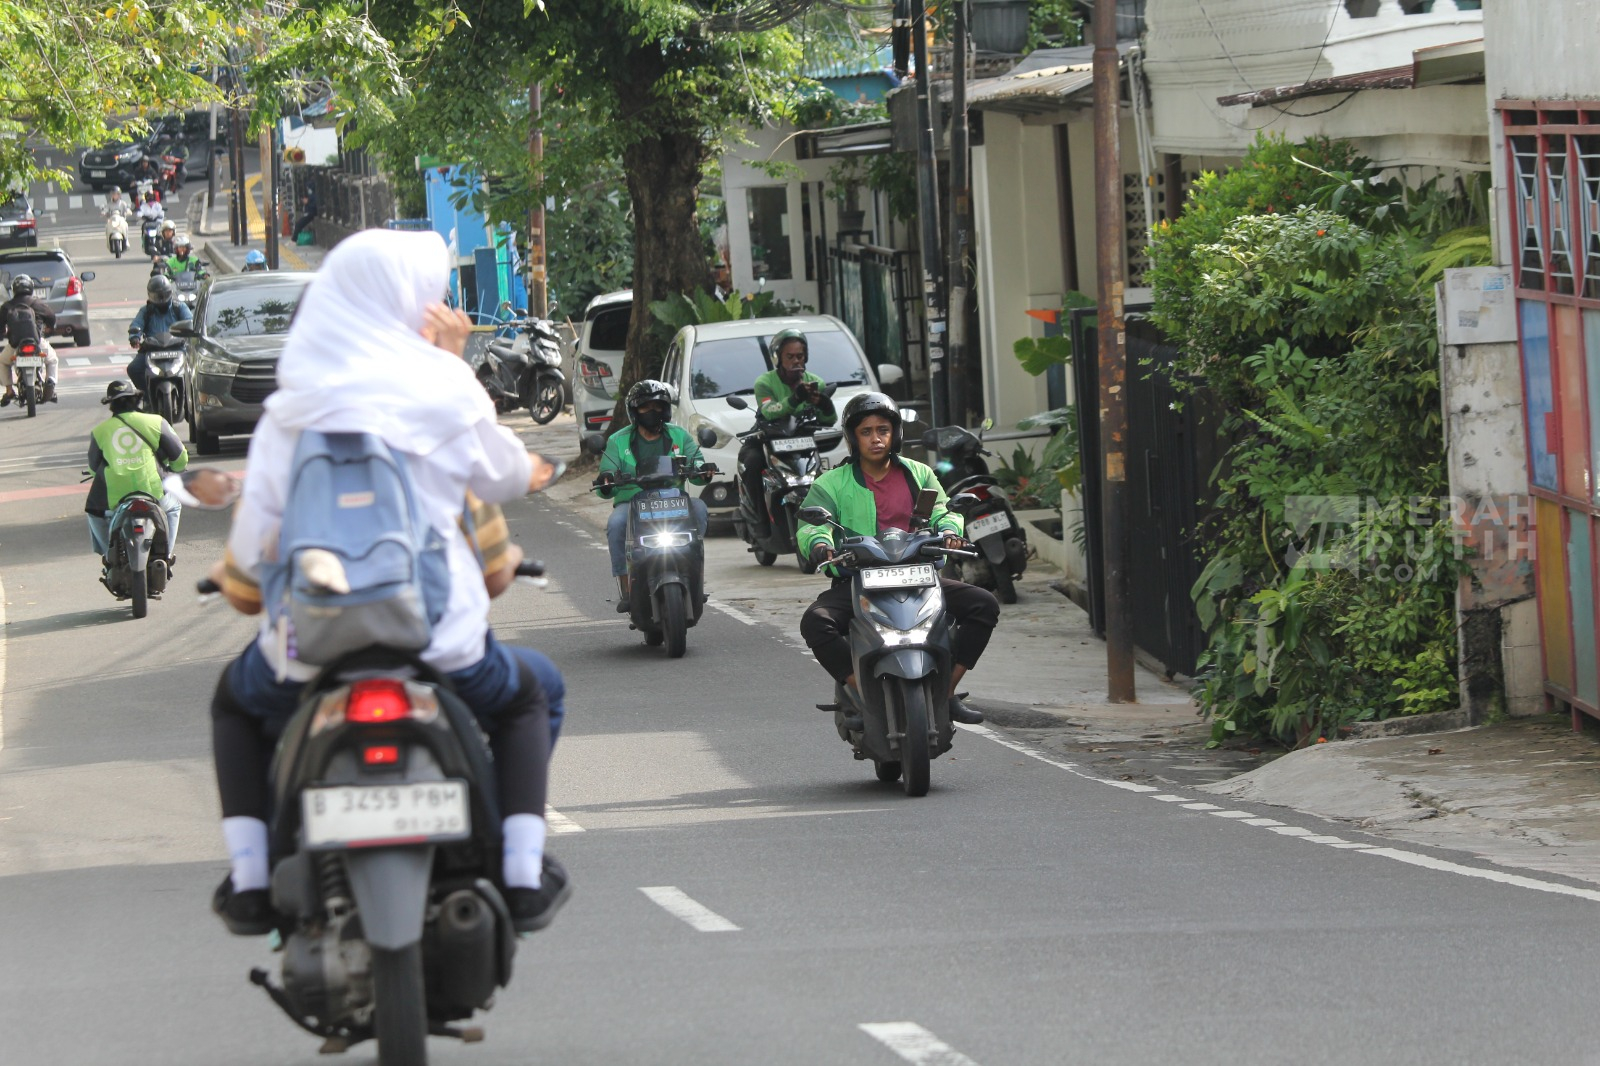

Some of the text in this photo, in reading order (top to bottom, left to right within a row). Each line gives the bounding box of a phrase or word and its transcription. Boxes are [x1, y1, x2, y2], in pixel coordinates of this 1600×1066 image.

[116, 457, 143, 466] gojek
[641, 502, 646, 510] B
[865, 571, 871, 579] B
[877, 568, 905, 578] 5755
[901, 576, 931, 584] 07-29
[314, 792, 326, 815] B
